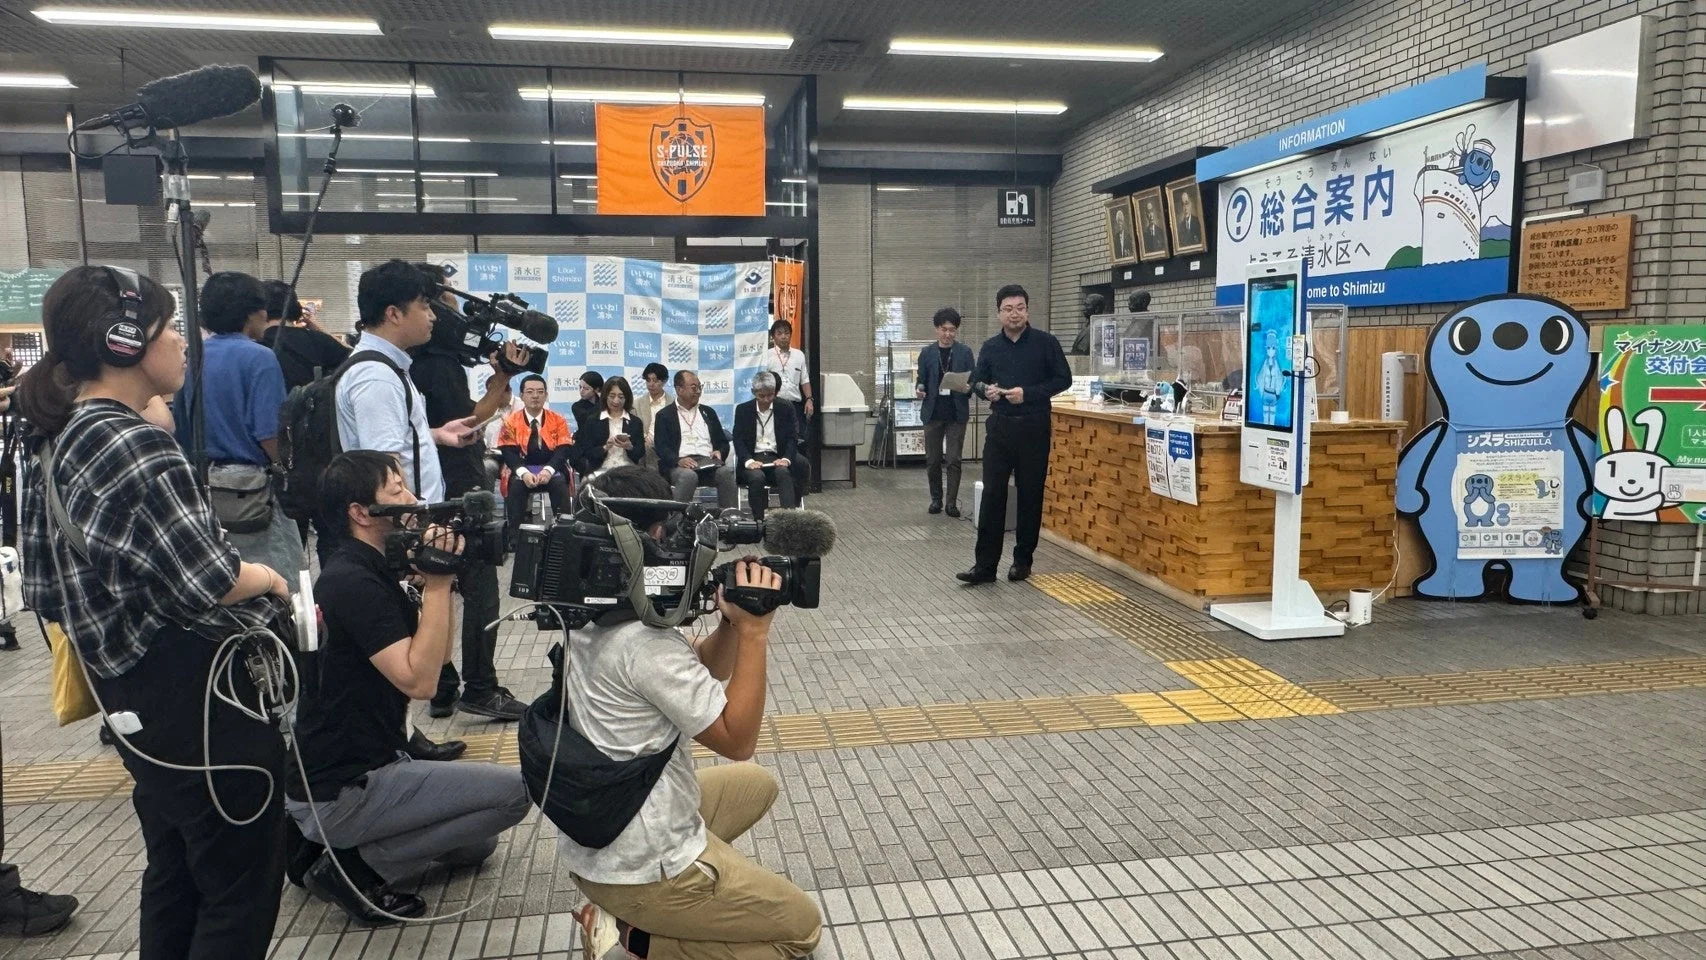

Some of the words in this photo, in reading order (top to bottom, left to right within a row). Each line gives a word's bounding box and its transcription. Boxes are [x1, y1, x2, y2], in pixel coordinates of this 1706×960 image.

[1279, 118, 1345, 152] INFORMATION
[657, 144, 708, 158] S-PULSE
[1260, 164, 1395, 239] 総合案内
[514, 266, 541, 276] 清水区
[480, 273, 497, 281] 清水
[552, 275, 583, 283] Shimizu
[667, 275, 694, 283] 清水区
[1306, 287, 1328, 299] ome
[1330, 284, 1340, 298] to
[1342, 280, 1386, 296] Shimizu
[592, 303, 618, 311] いいね!
[629, 307, 656, 315] 清水区
[597, 312, 614, 320] 清水
[592, 341, 618, 349] 清水区
[704, 344, 729, 352] いいね!
[559, 348, 575, 356] 清水
[628, 349, 658, 358] Shimizu
[710, 352, 724, 360] 清水
[1644, 355, 1706, 375] 交付会
[1467, 431, 1504, 448] シズラ
[1504, 438, 1552, 447] SHIZULLA
[1677, 455, 1693, 465] My
[430, 556, 449, 565] SONY
